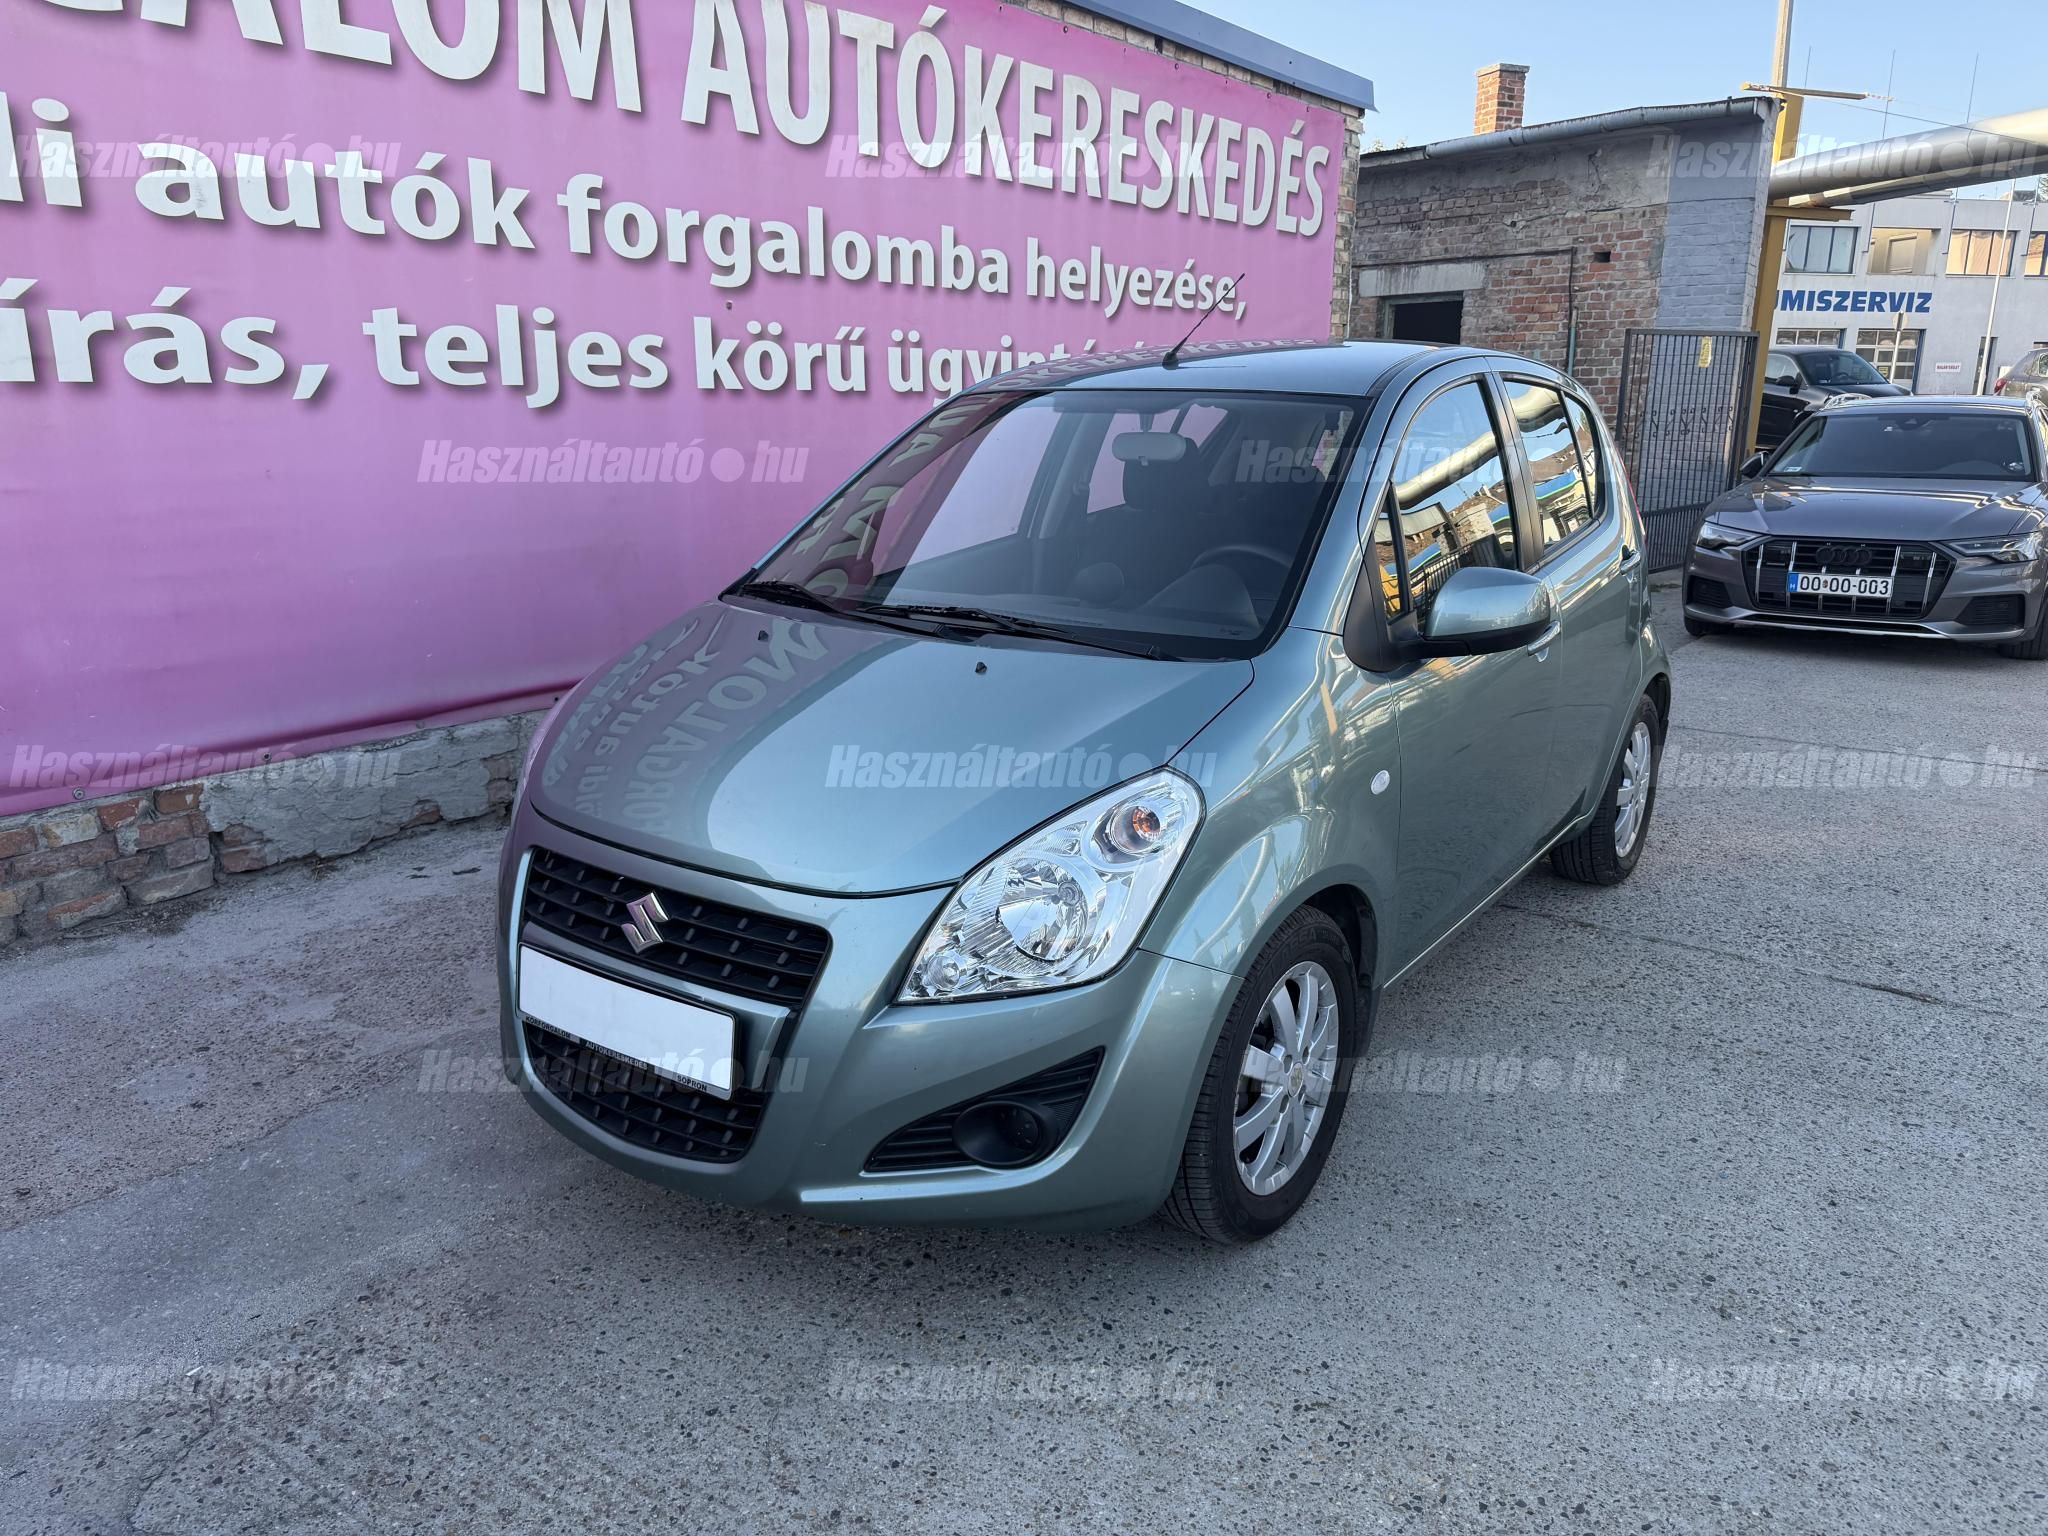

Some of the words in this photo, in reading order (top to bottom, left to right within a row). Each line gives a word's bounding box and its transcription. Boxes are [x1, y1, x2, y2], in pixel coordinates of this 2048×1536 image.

[681, 0, 1329, 237] AUTÓKERESKEDÉS
[135, 151, 535, 249] autók
[557, 174, 1008, 289] forgalomba
[1027, 236, 1246, 320] helyezése,
[1774, 289, 1933, 313] MISZERVIZ
[363, 303, 669, 409] teljes
[694, 316, 866, 391] körű
[677, 1073, 708, 1092] SOPRON
